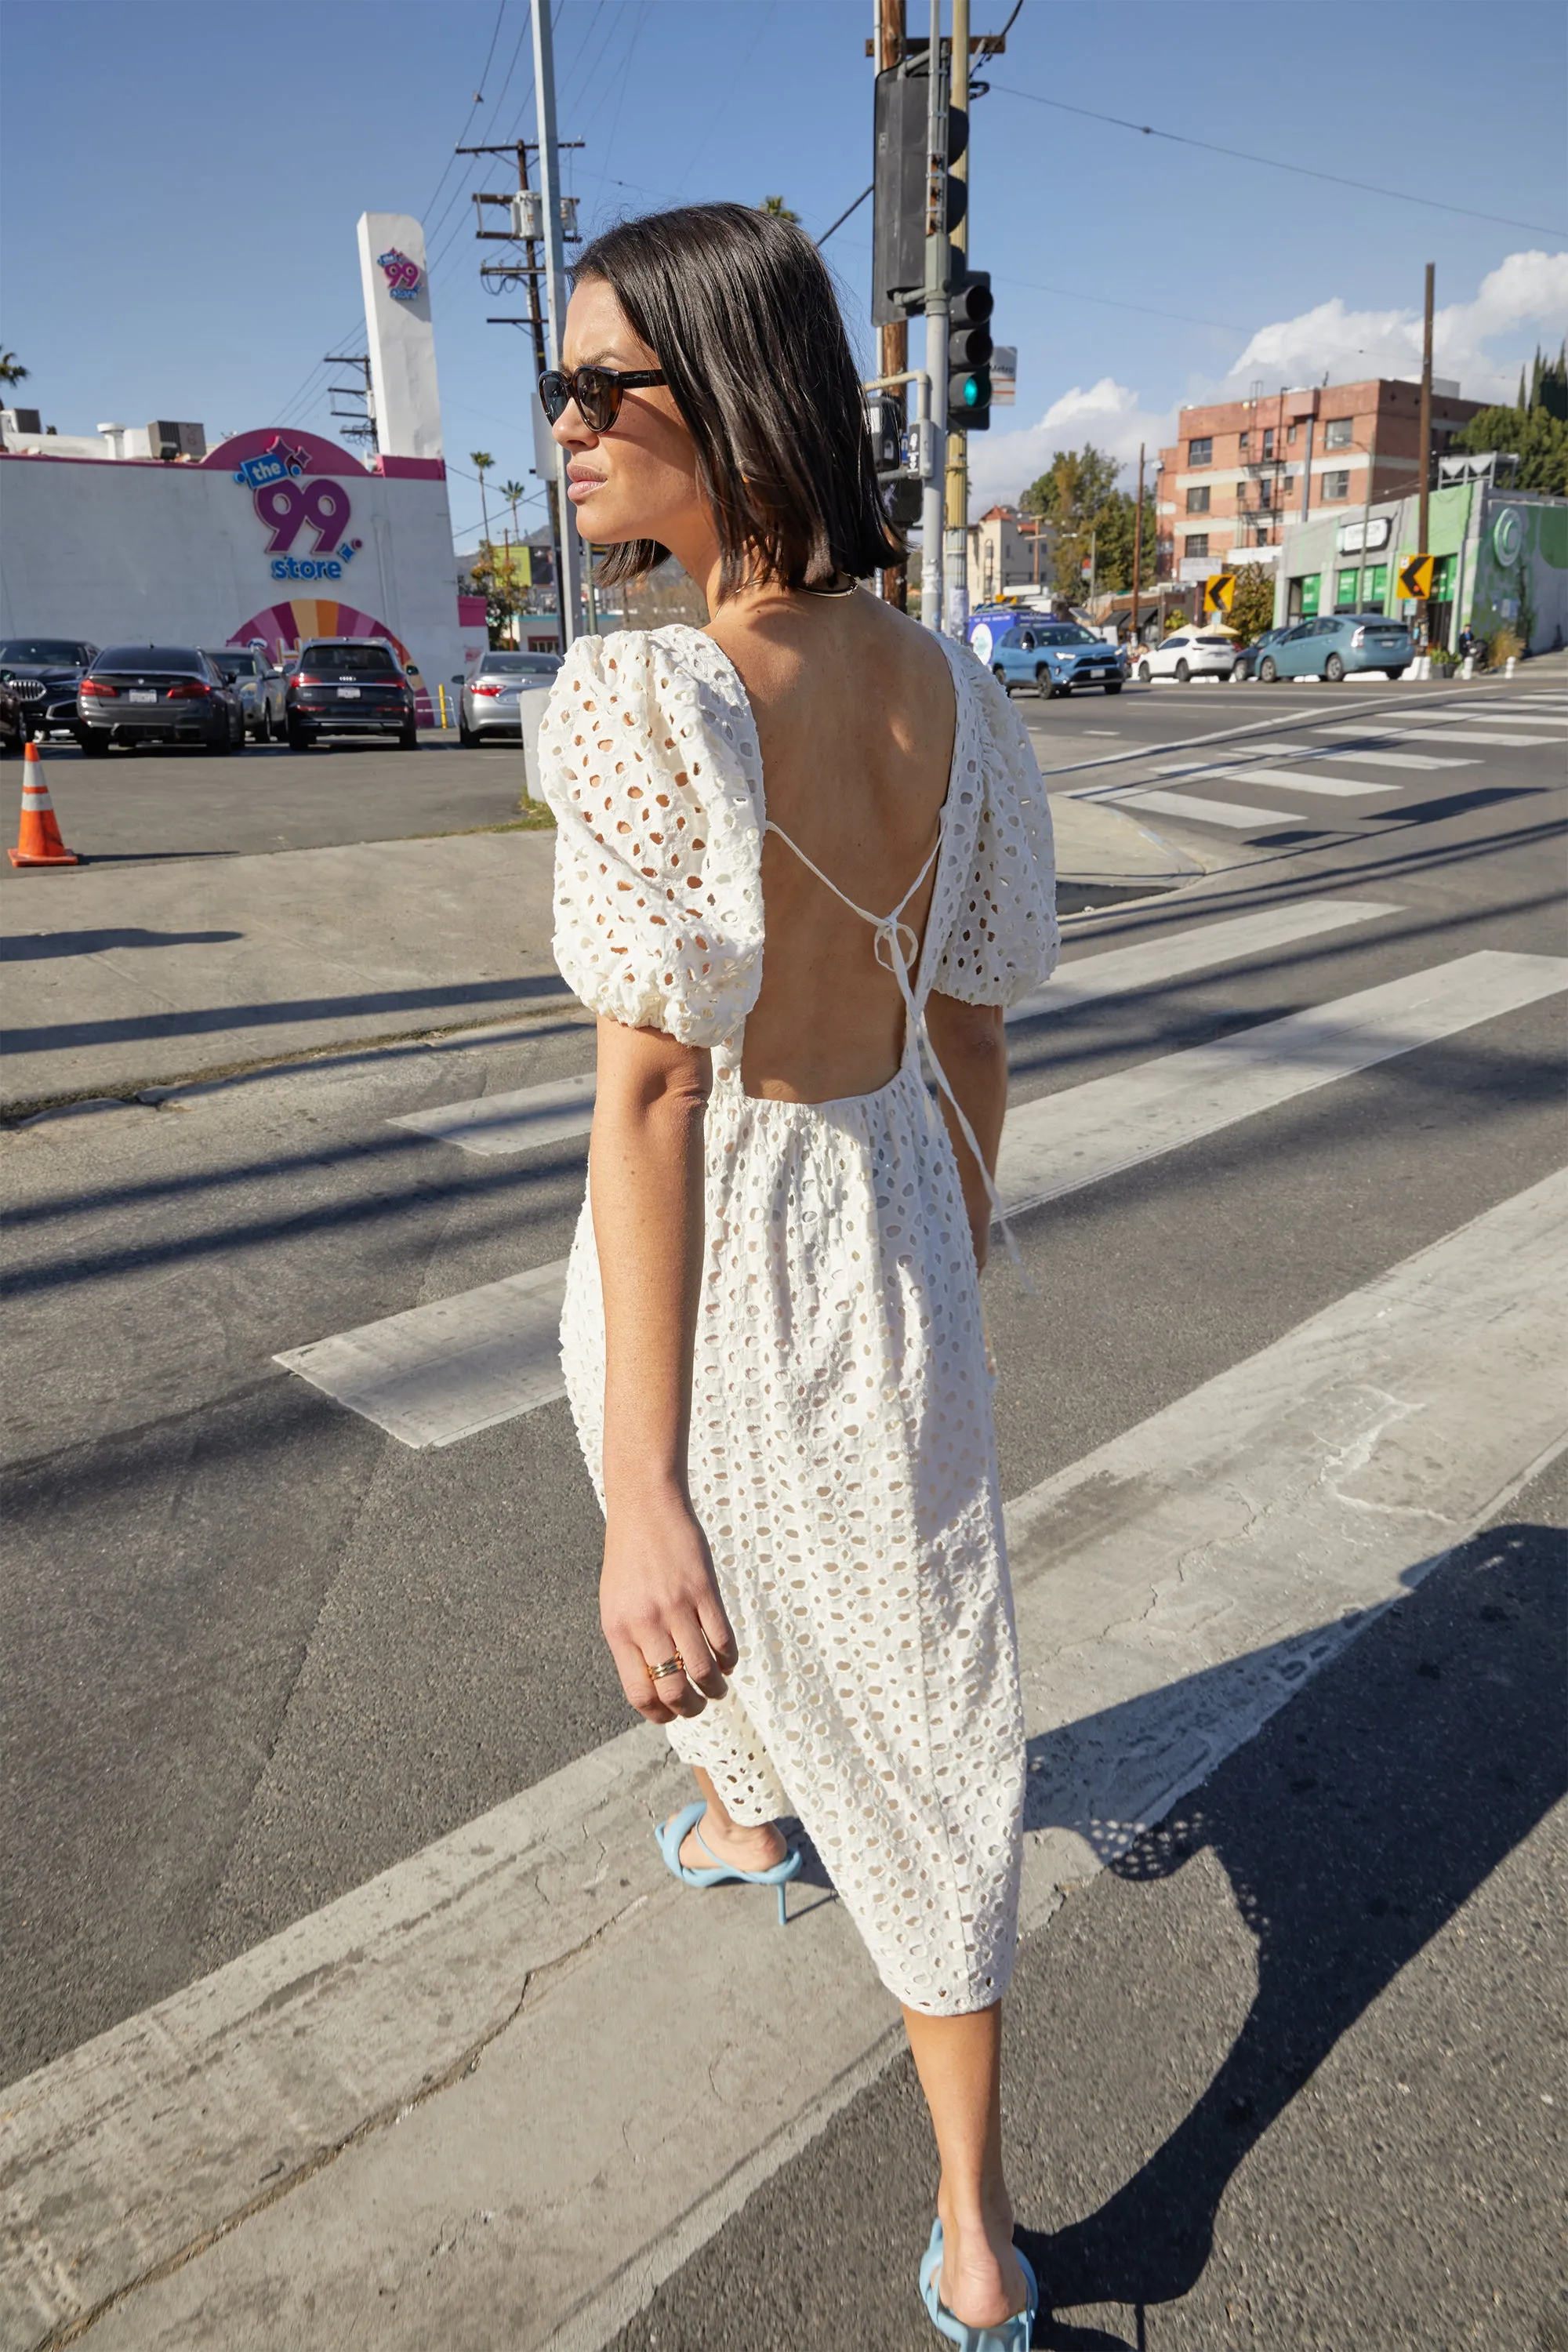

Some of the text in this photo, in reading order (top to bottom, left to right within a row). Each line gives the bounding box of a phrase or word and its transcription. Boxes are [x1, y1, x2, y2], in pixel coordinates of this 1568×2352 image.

[383, 262, 419, 289] 99
[252, 462, 281, 481] the
[253, 477, 350, 554] 99
[271, 557, 341, 580] store
